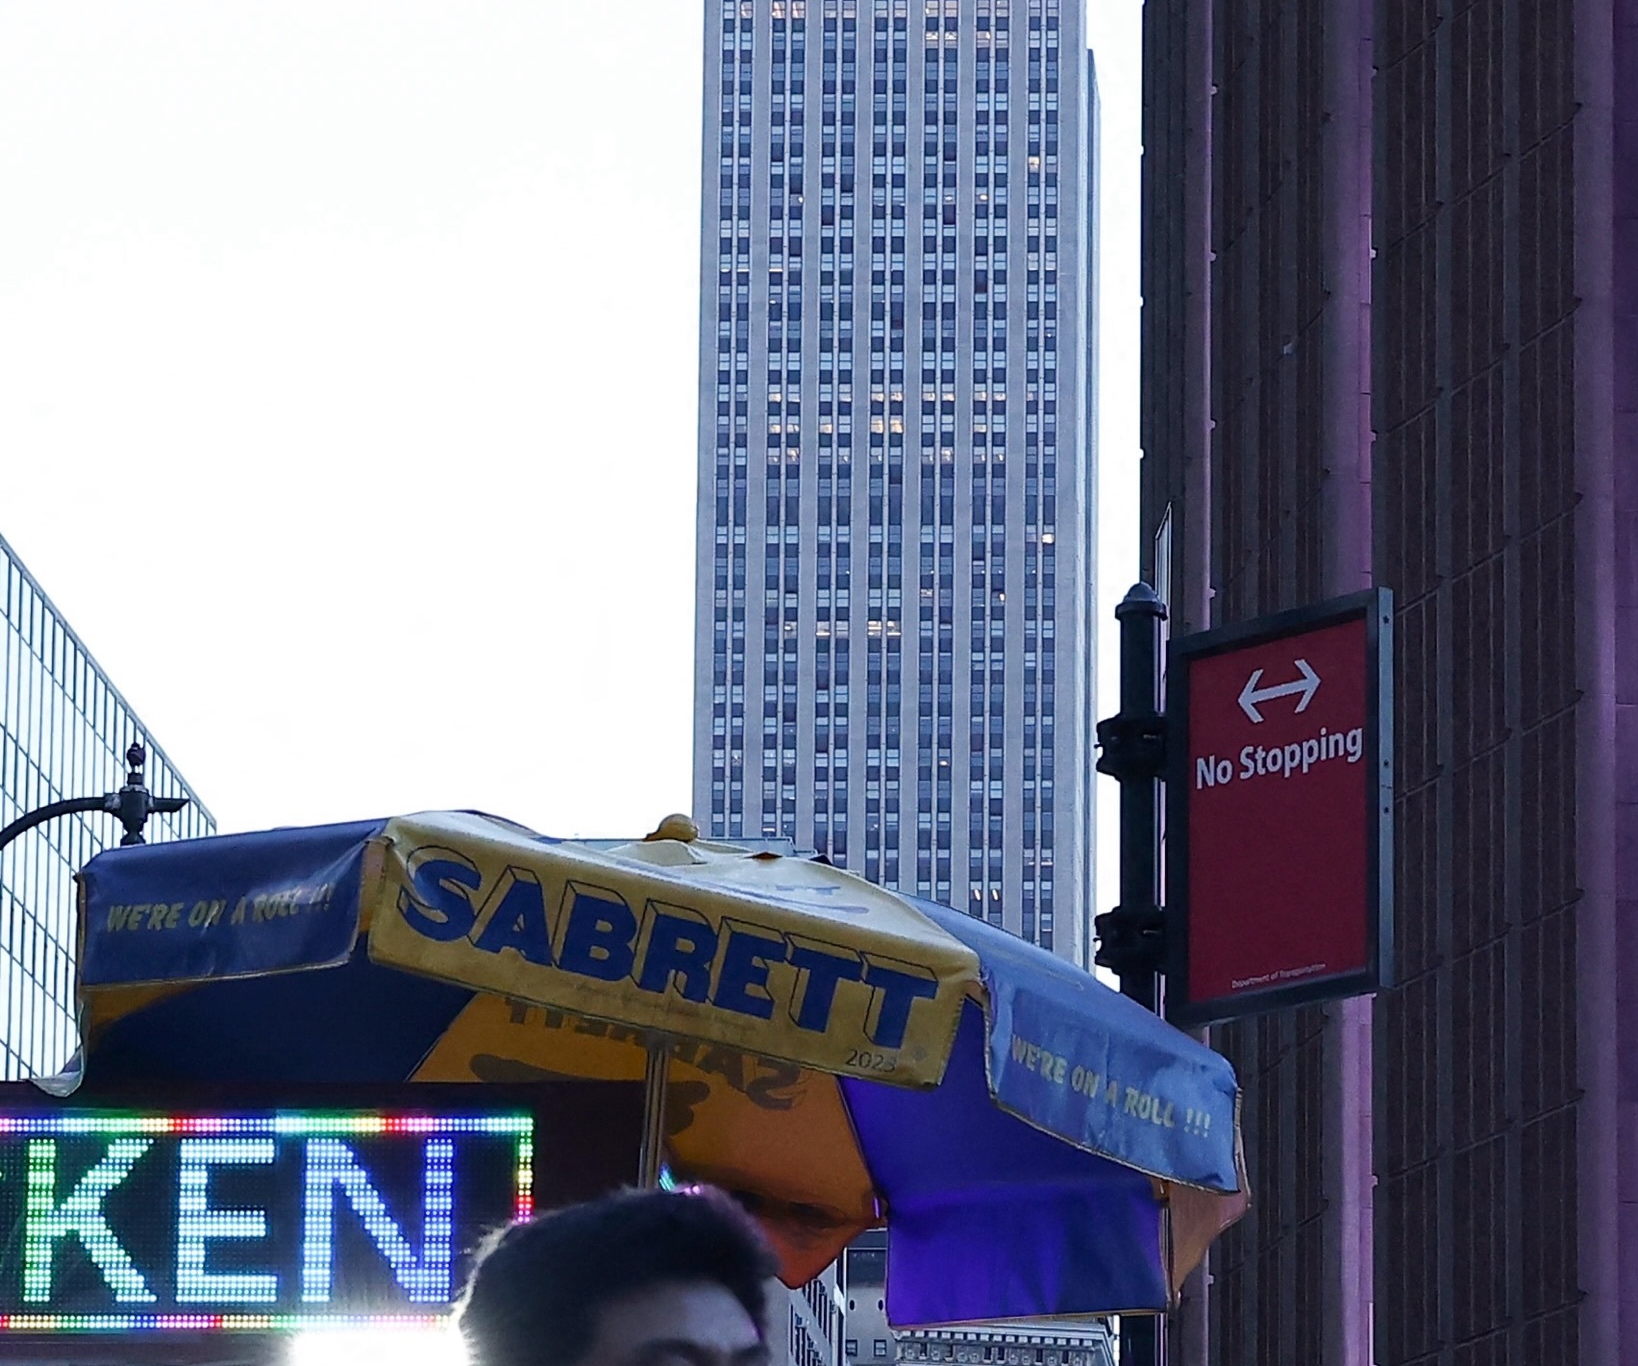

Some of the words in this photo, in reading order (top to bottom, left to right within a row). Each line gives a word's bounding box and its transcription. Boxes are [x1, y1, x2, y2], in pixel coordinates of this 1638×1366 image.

[1196, 754, 1233, 790] No
[1239, 727, 1363, 780] Stopping
[107, 901, 185, 933] WE'RE
[188, 899, 226, 928] ON
[231, 895, 247, 925] A
[398, 845, 939, 1049] SABRETT
[1012, 1035, 1068, 1084] WE'RE
[1072, 1064, 1100, 1098] ON
[1104, 1080, 1119, 1107] A
[1123, 1087, 1176, 1128] ROLL
